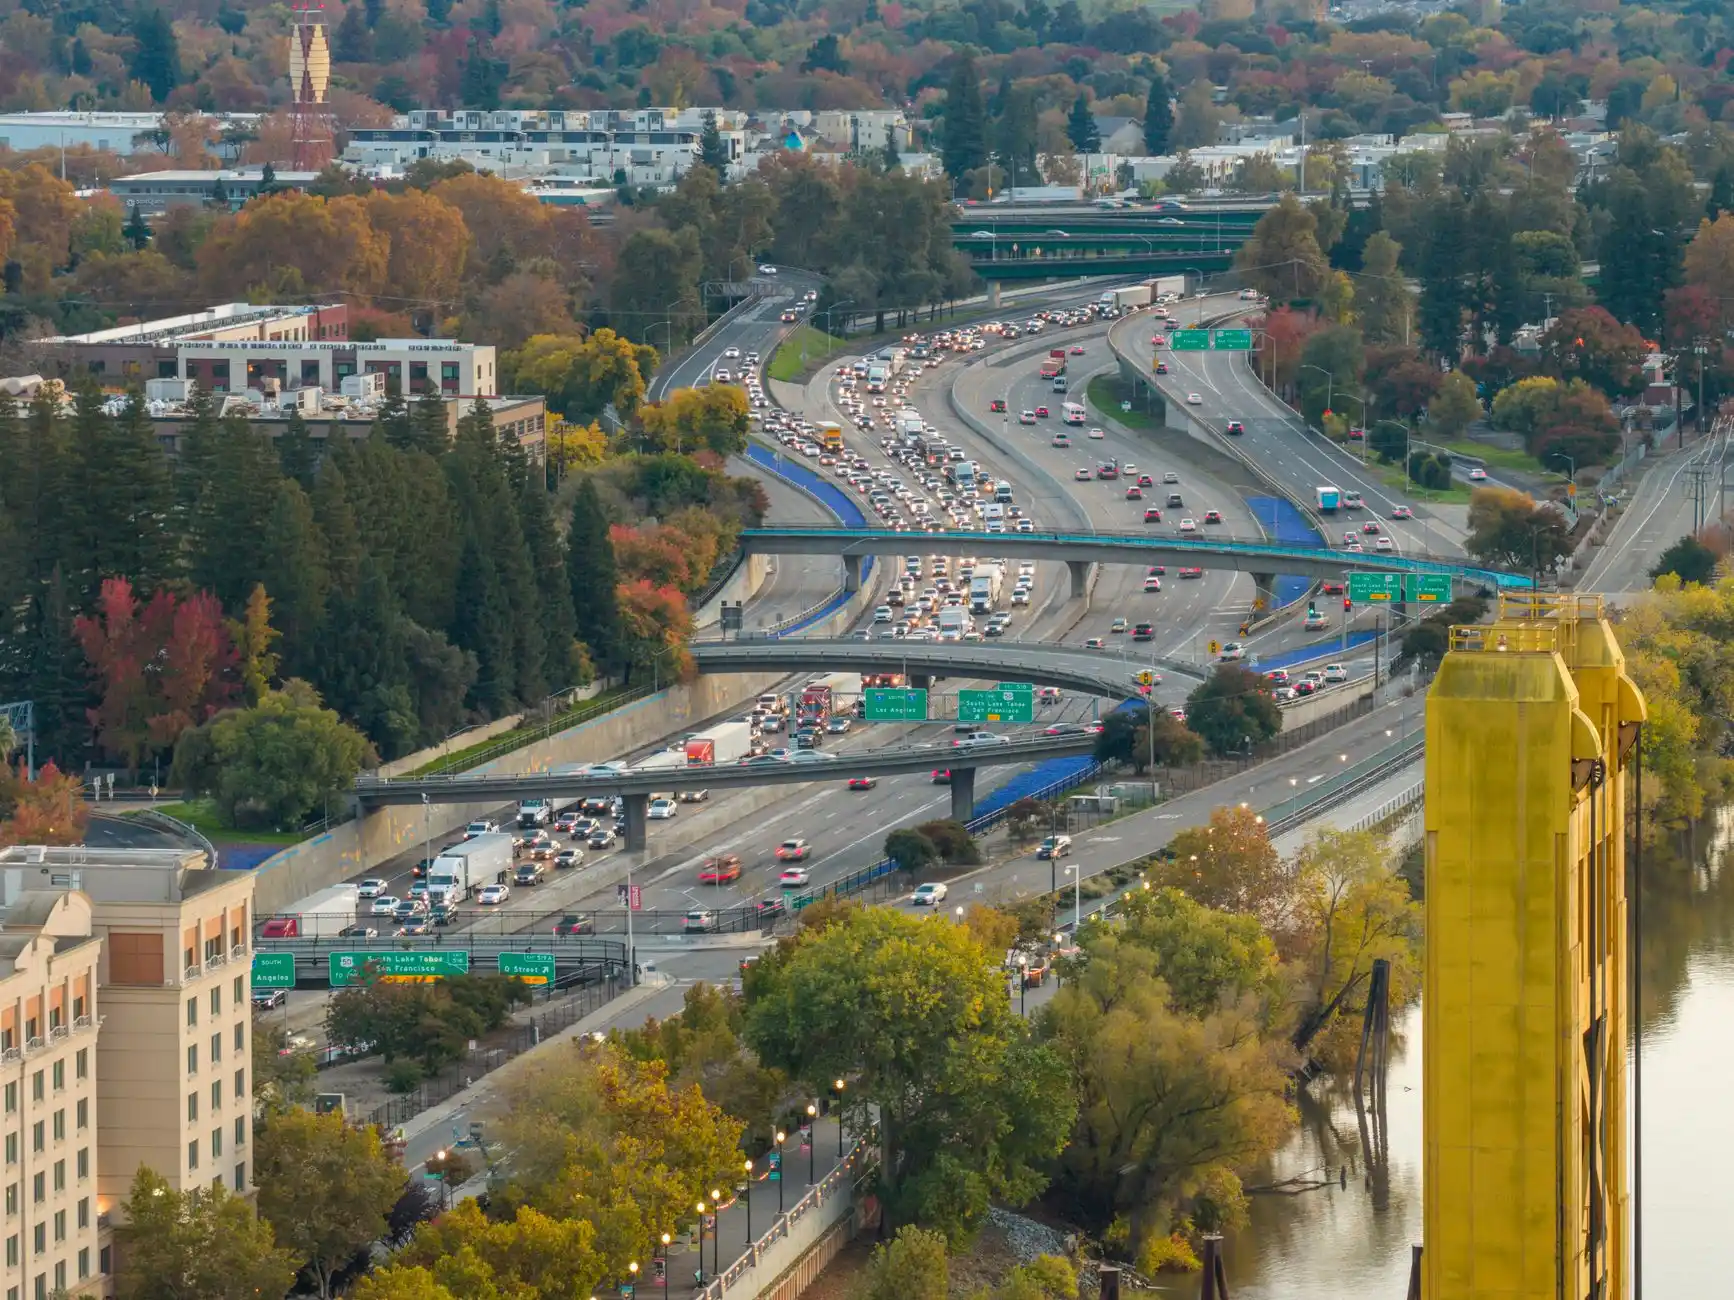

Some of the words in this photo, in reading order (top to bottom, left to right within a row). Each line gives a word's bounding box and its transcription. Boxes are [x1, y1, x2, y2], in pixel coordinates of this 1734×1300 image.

[420, 955, 443, 963] Tahoe
[395, 964, 436, 972] Francisco
[513, 965, 538, 973] Street
[256, 973, 289, 983] Angeles
